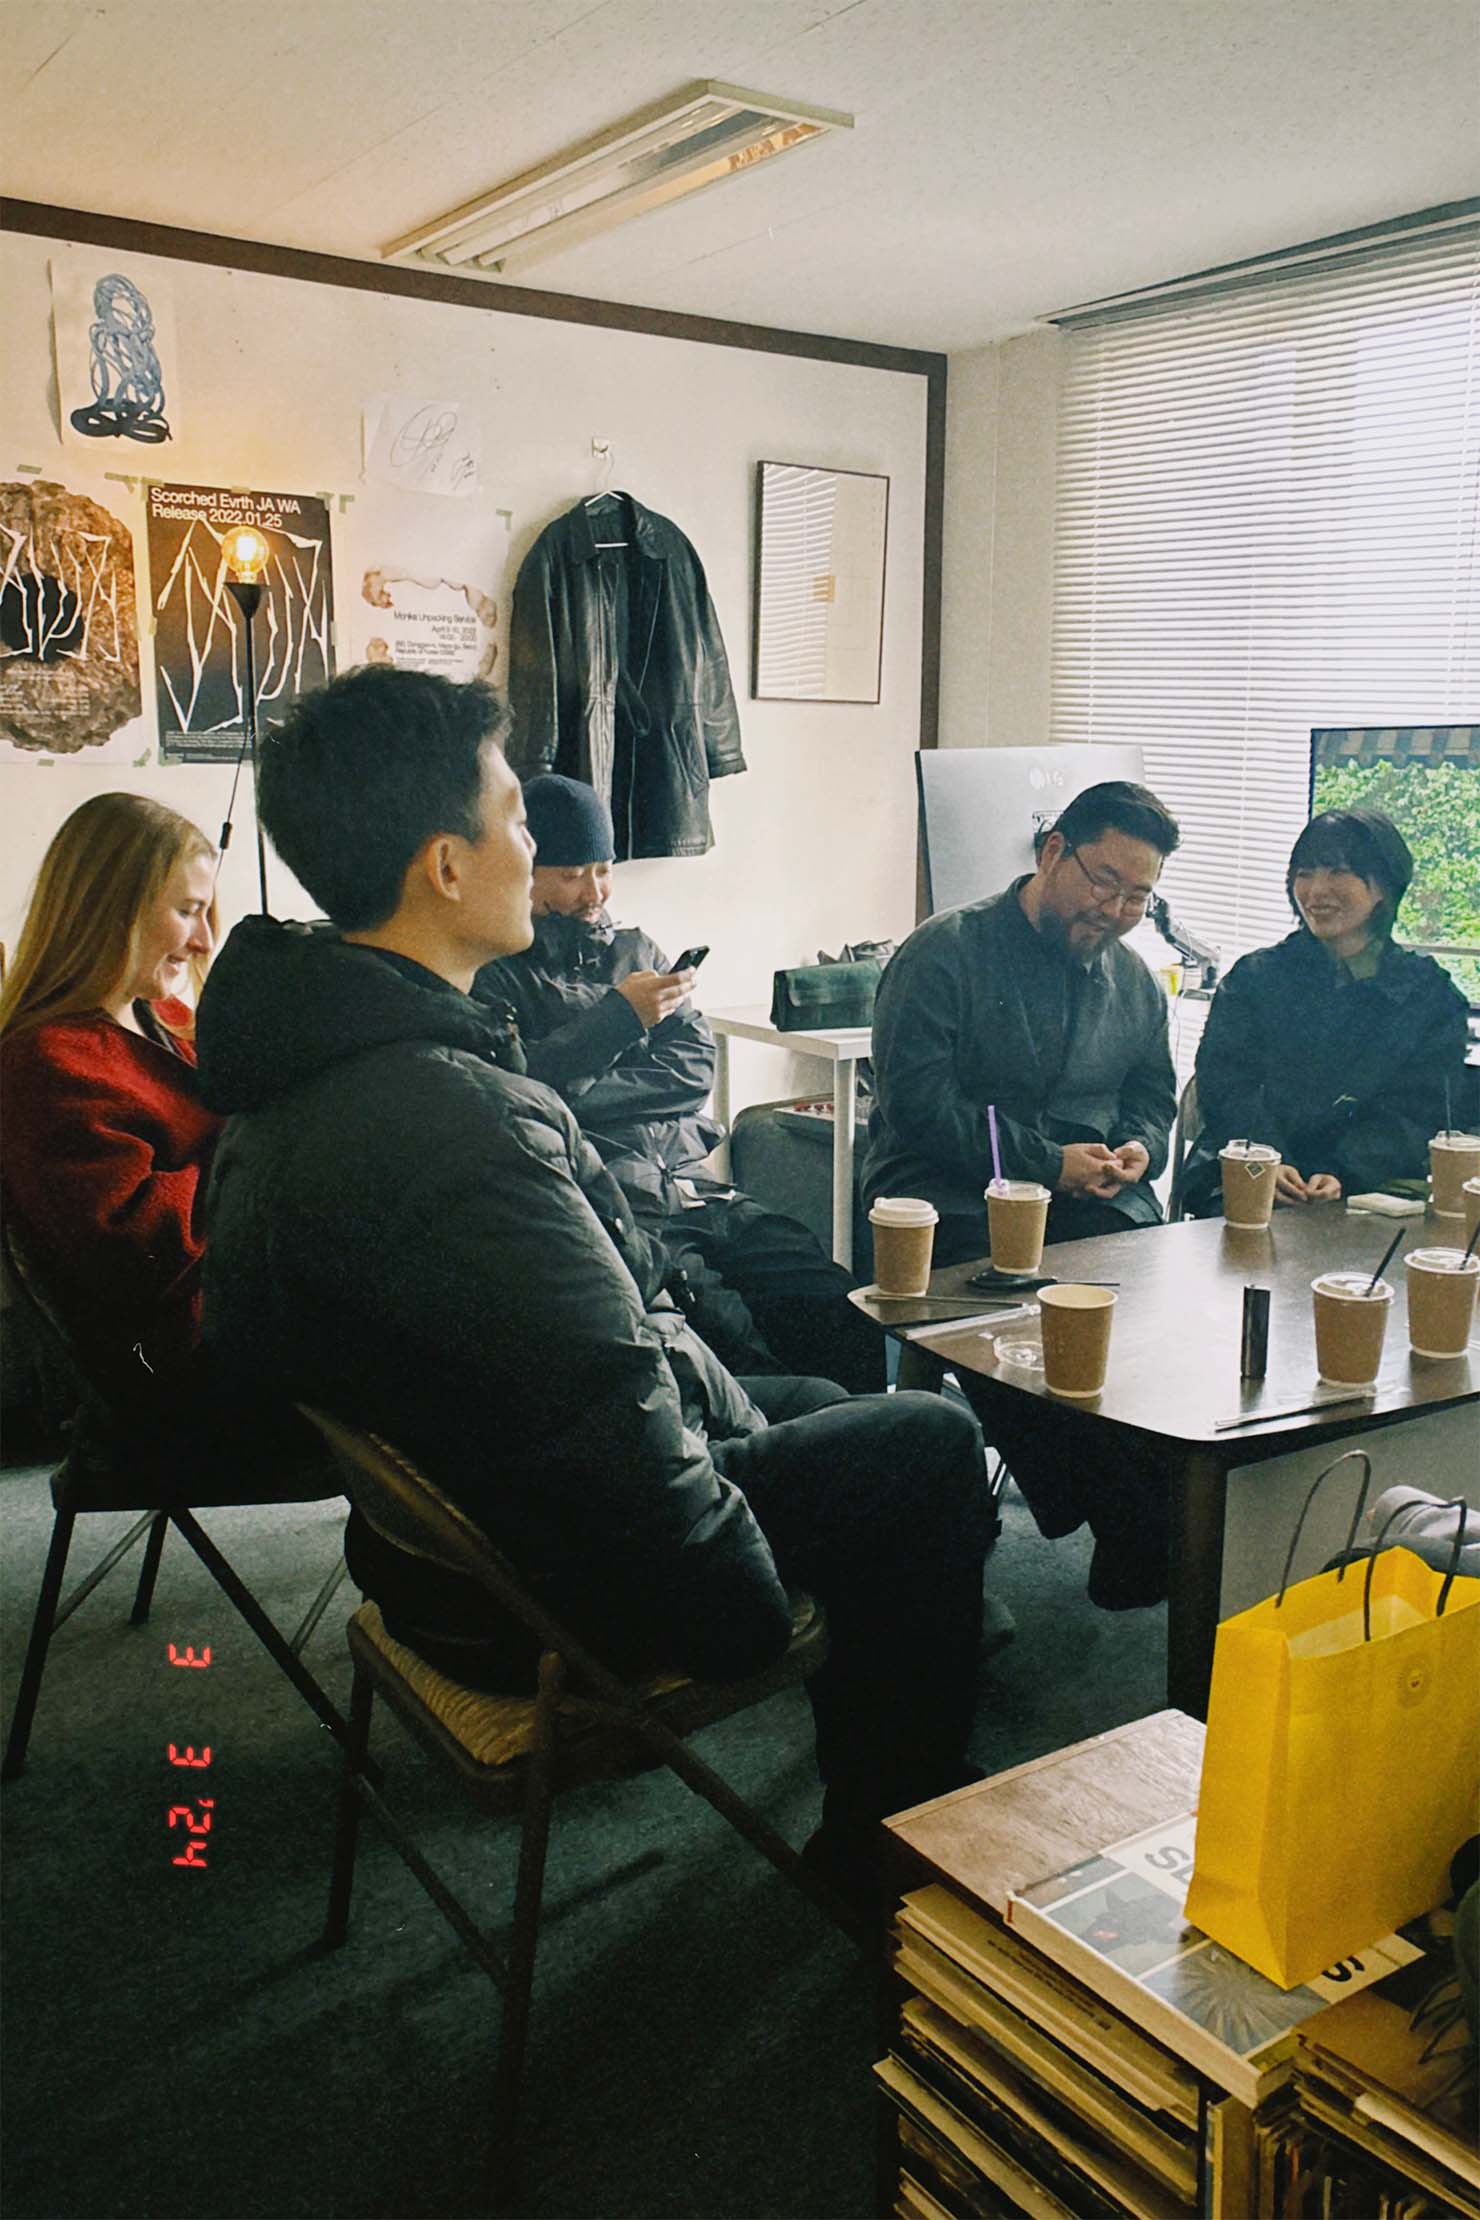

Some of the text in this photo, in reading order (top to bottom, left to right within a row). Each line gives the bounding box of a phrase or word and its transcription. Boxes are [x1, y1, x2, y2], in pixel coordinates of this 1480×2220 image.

[151, 487, 301, 515] Scorched Evrth JA WA
[152, 504, 283, 528] Release 2022.01.25
